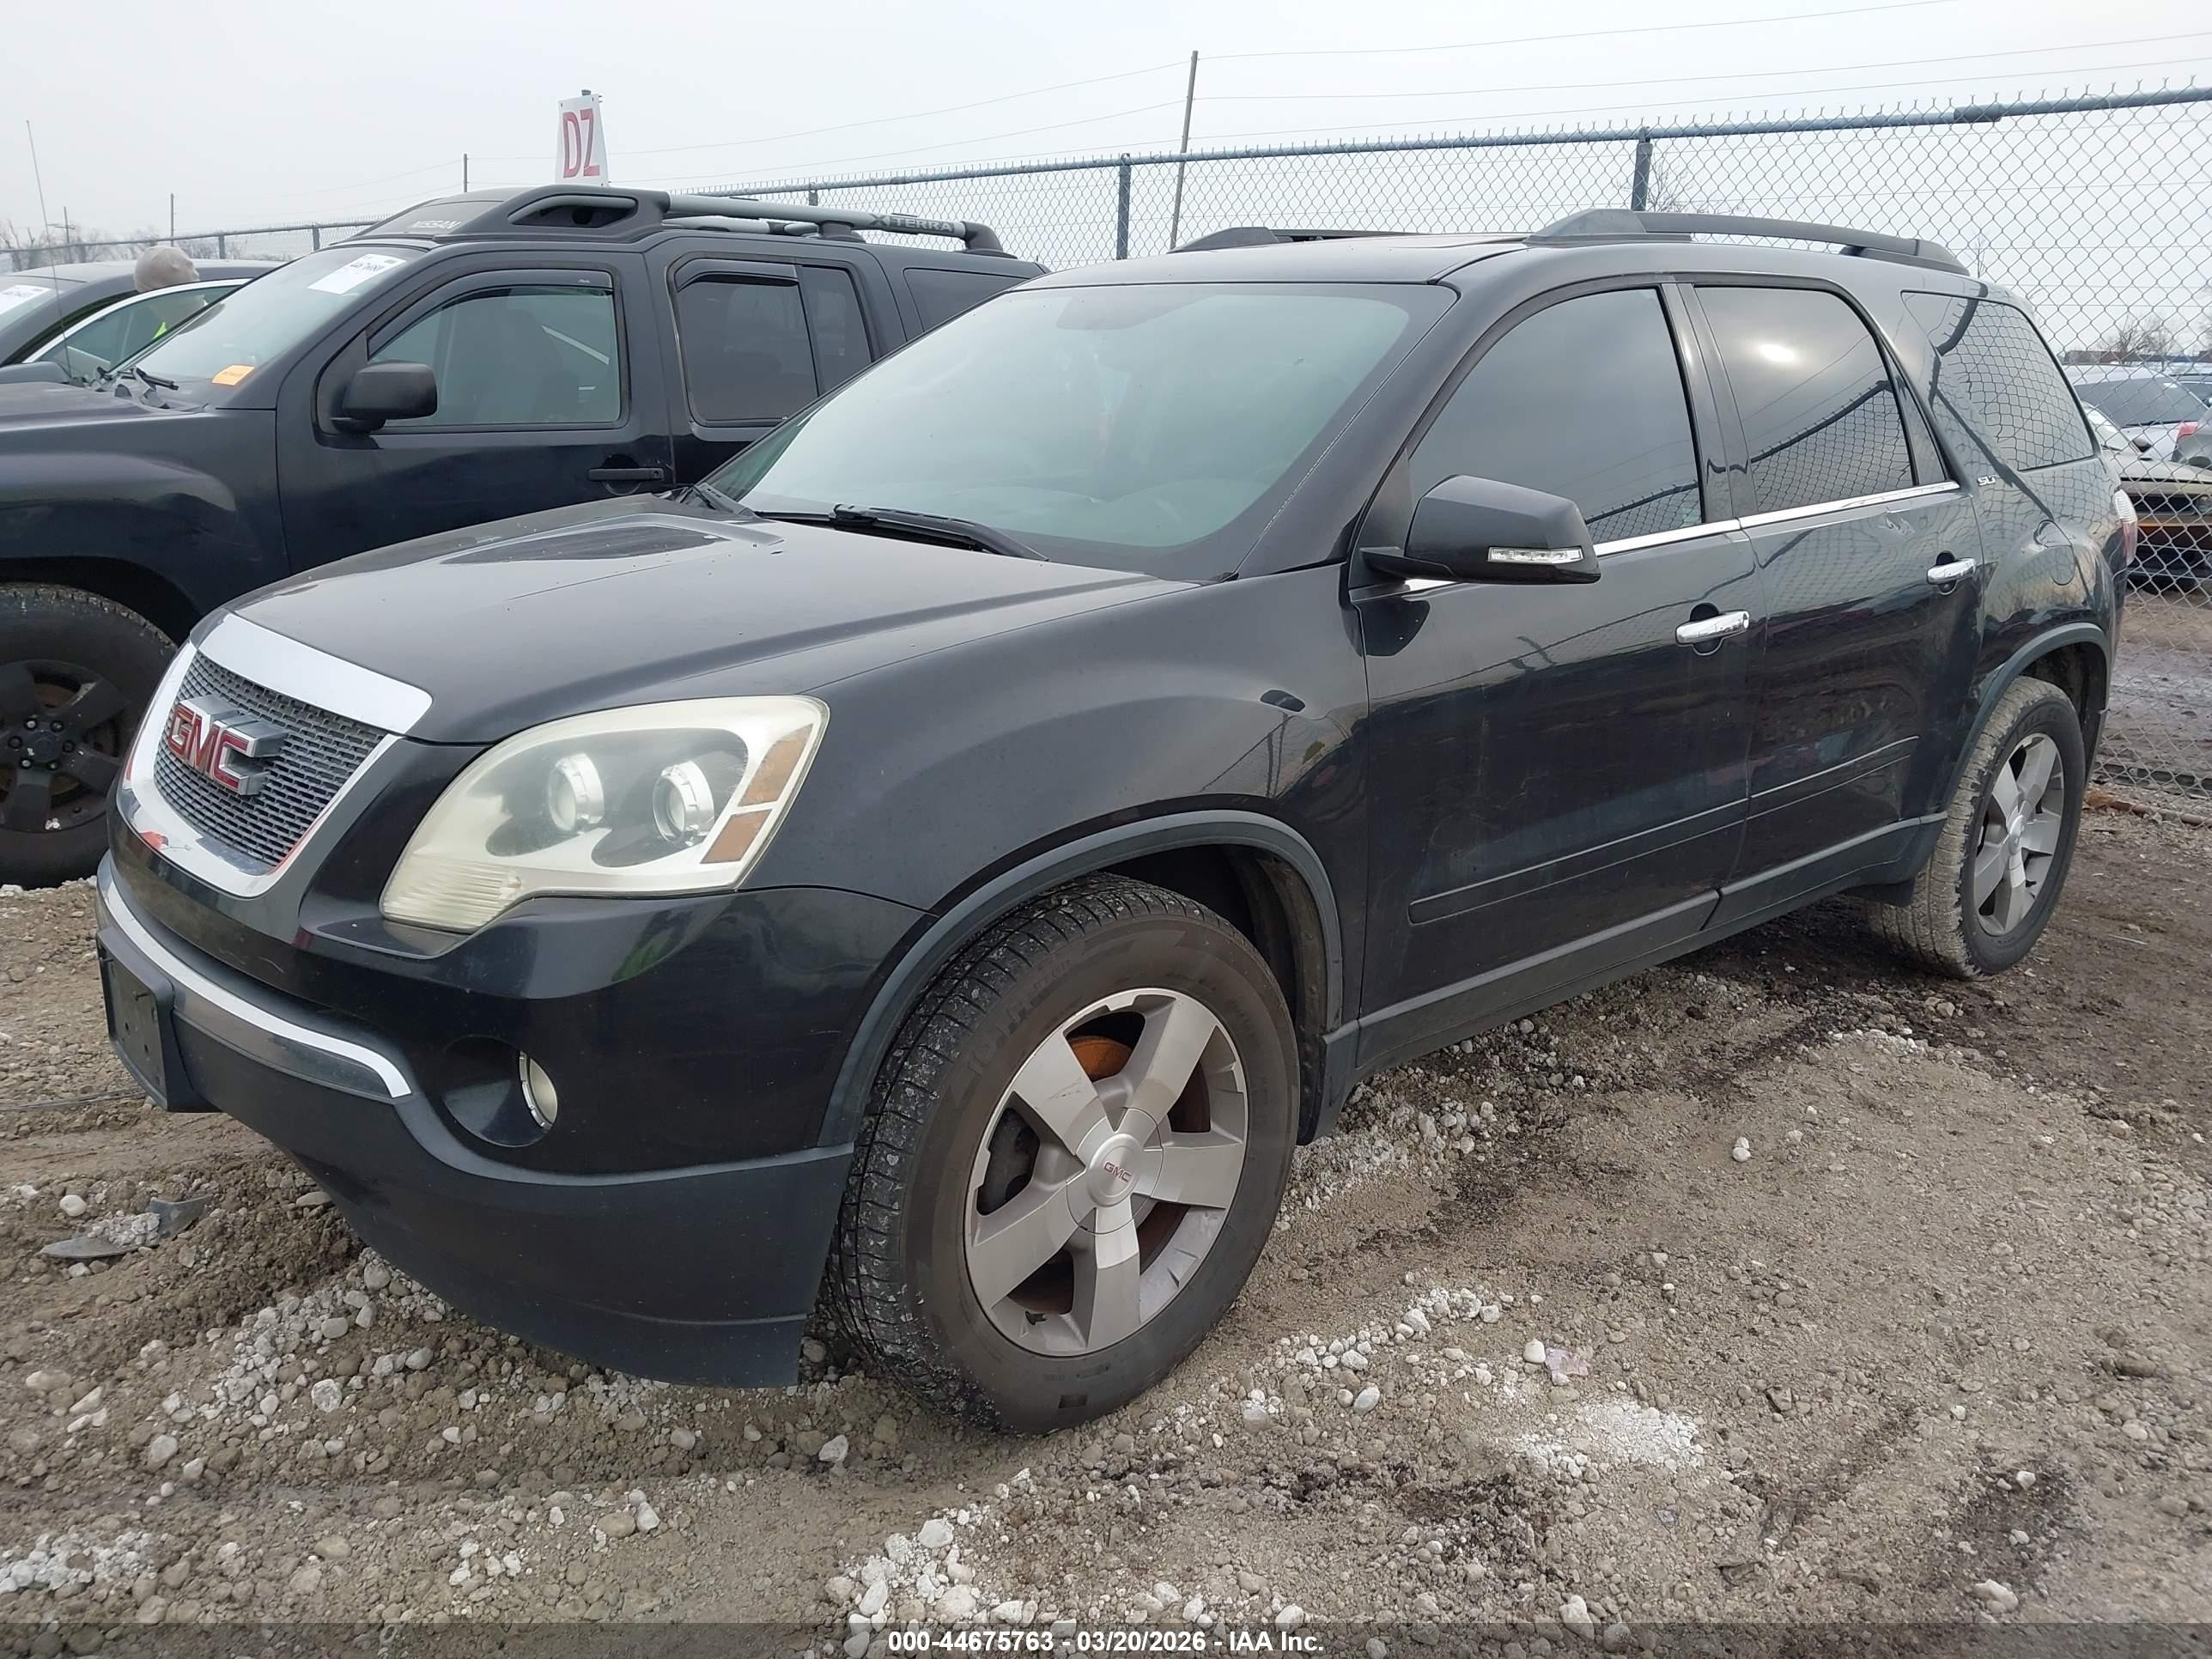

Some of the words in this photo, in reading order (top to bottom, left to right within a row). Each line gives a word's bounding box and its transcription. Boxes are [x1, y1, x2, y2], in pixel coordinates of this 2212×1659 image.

[869, 212, 954, 234] XTERRA
[167, 700, 257, 796] GMC
[1103, 1161, 1133, 1183] GMC
